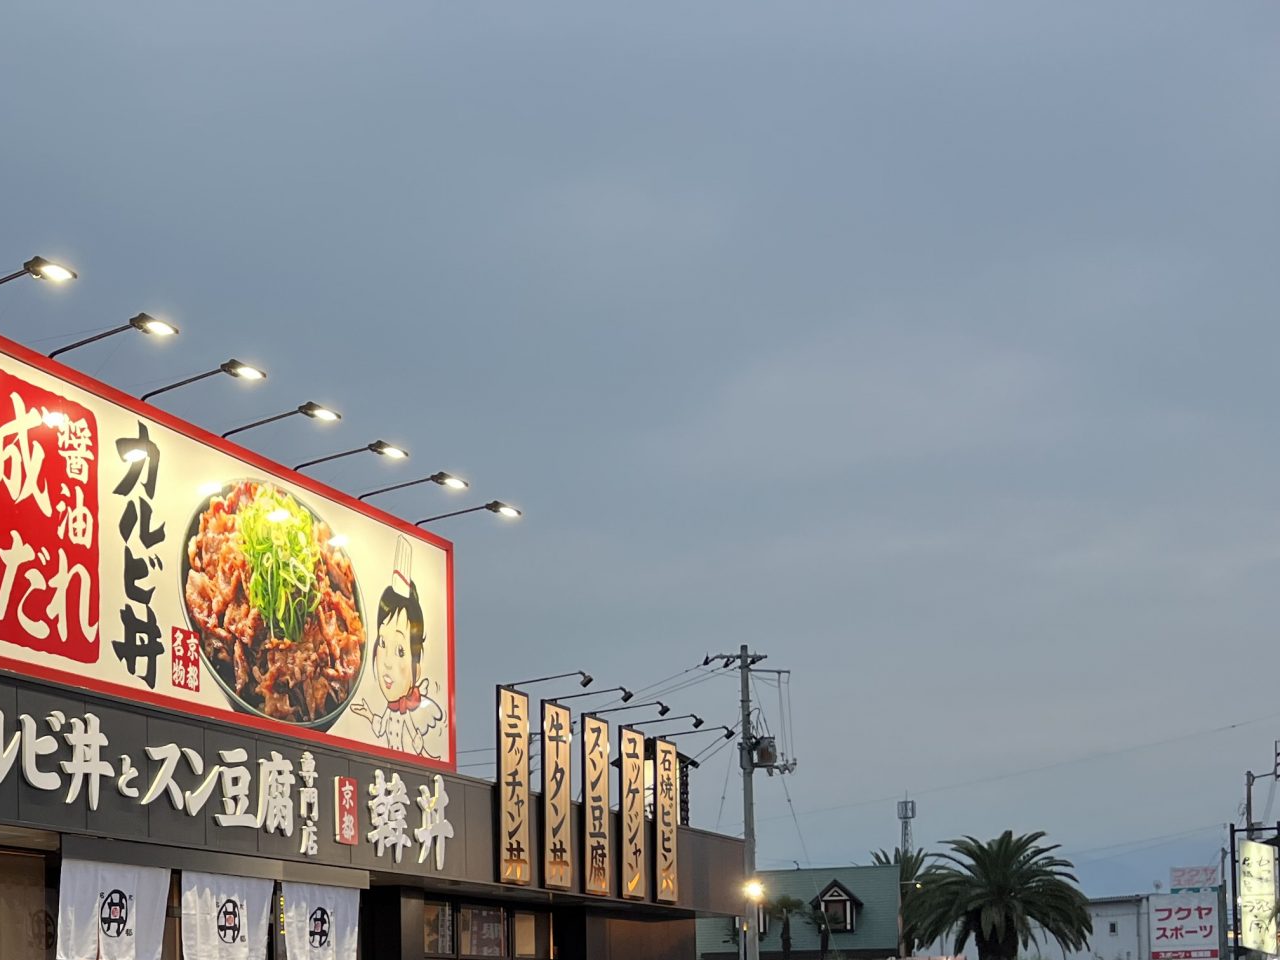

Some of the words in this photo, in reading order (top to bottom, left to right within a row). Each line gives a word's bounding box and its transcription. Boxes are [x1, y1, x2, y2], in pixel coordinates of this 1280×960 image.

[56, 410, 96, 550] 醤油
[112, 419, 166, 690] カルビ丼
[172, 629, 185, 686] 名物
[186, 633, 199, 691] 京都
[299, 751, 319, 856] 専門店
[341, 780, 355, 842] 京都
[367, 768, 455, 872] 韓丼
[504, 694, 528, 880] 上テッチャン丼
[547, 711, 570, 884] 牛タン丼
[588, 725, 608, 890] スン豆腐
[625, 737, 643, 893] ユッケジャン
[1154, 906, 1213, 922] フクヤ
[1155, 925, 1213, 940] スポーツ
